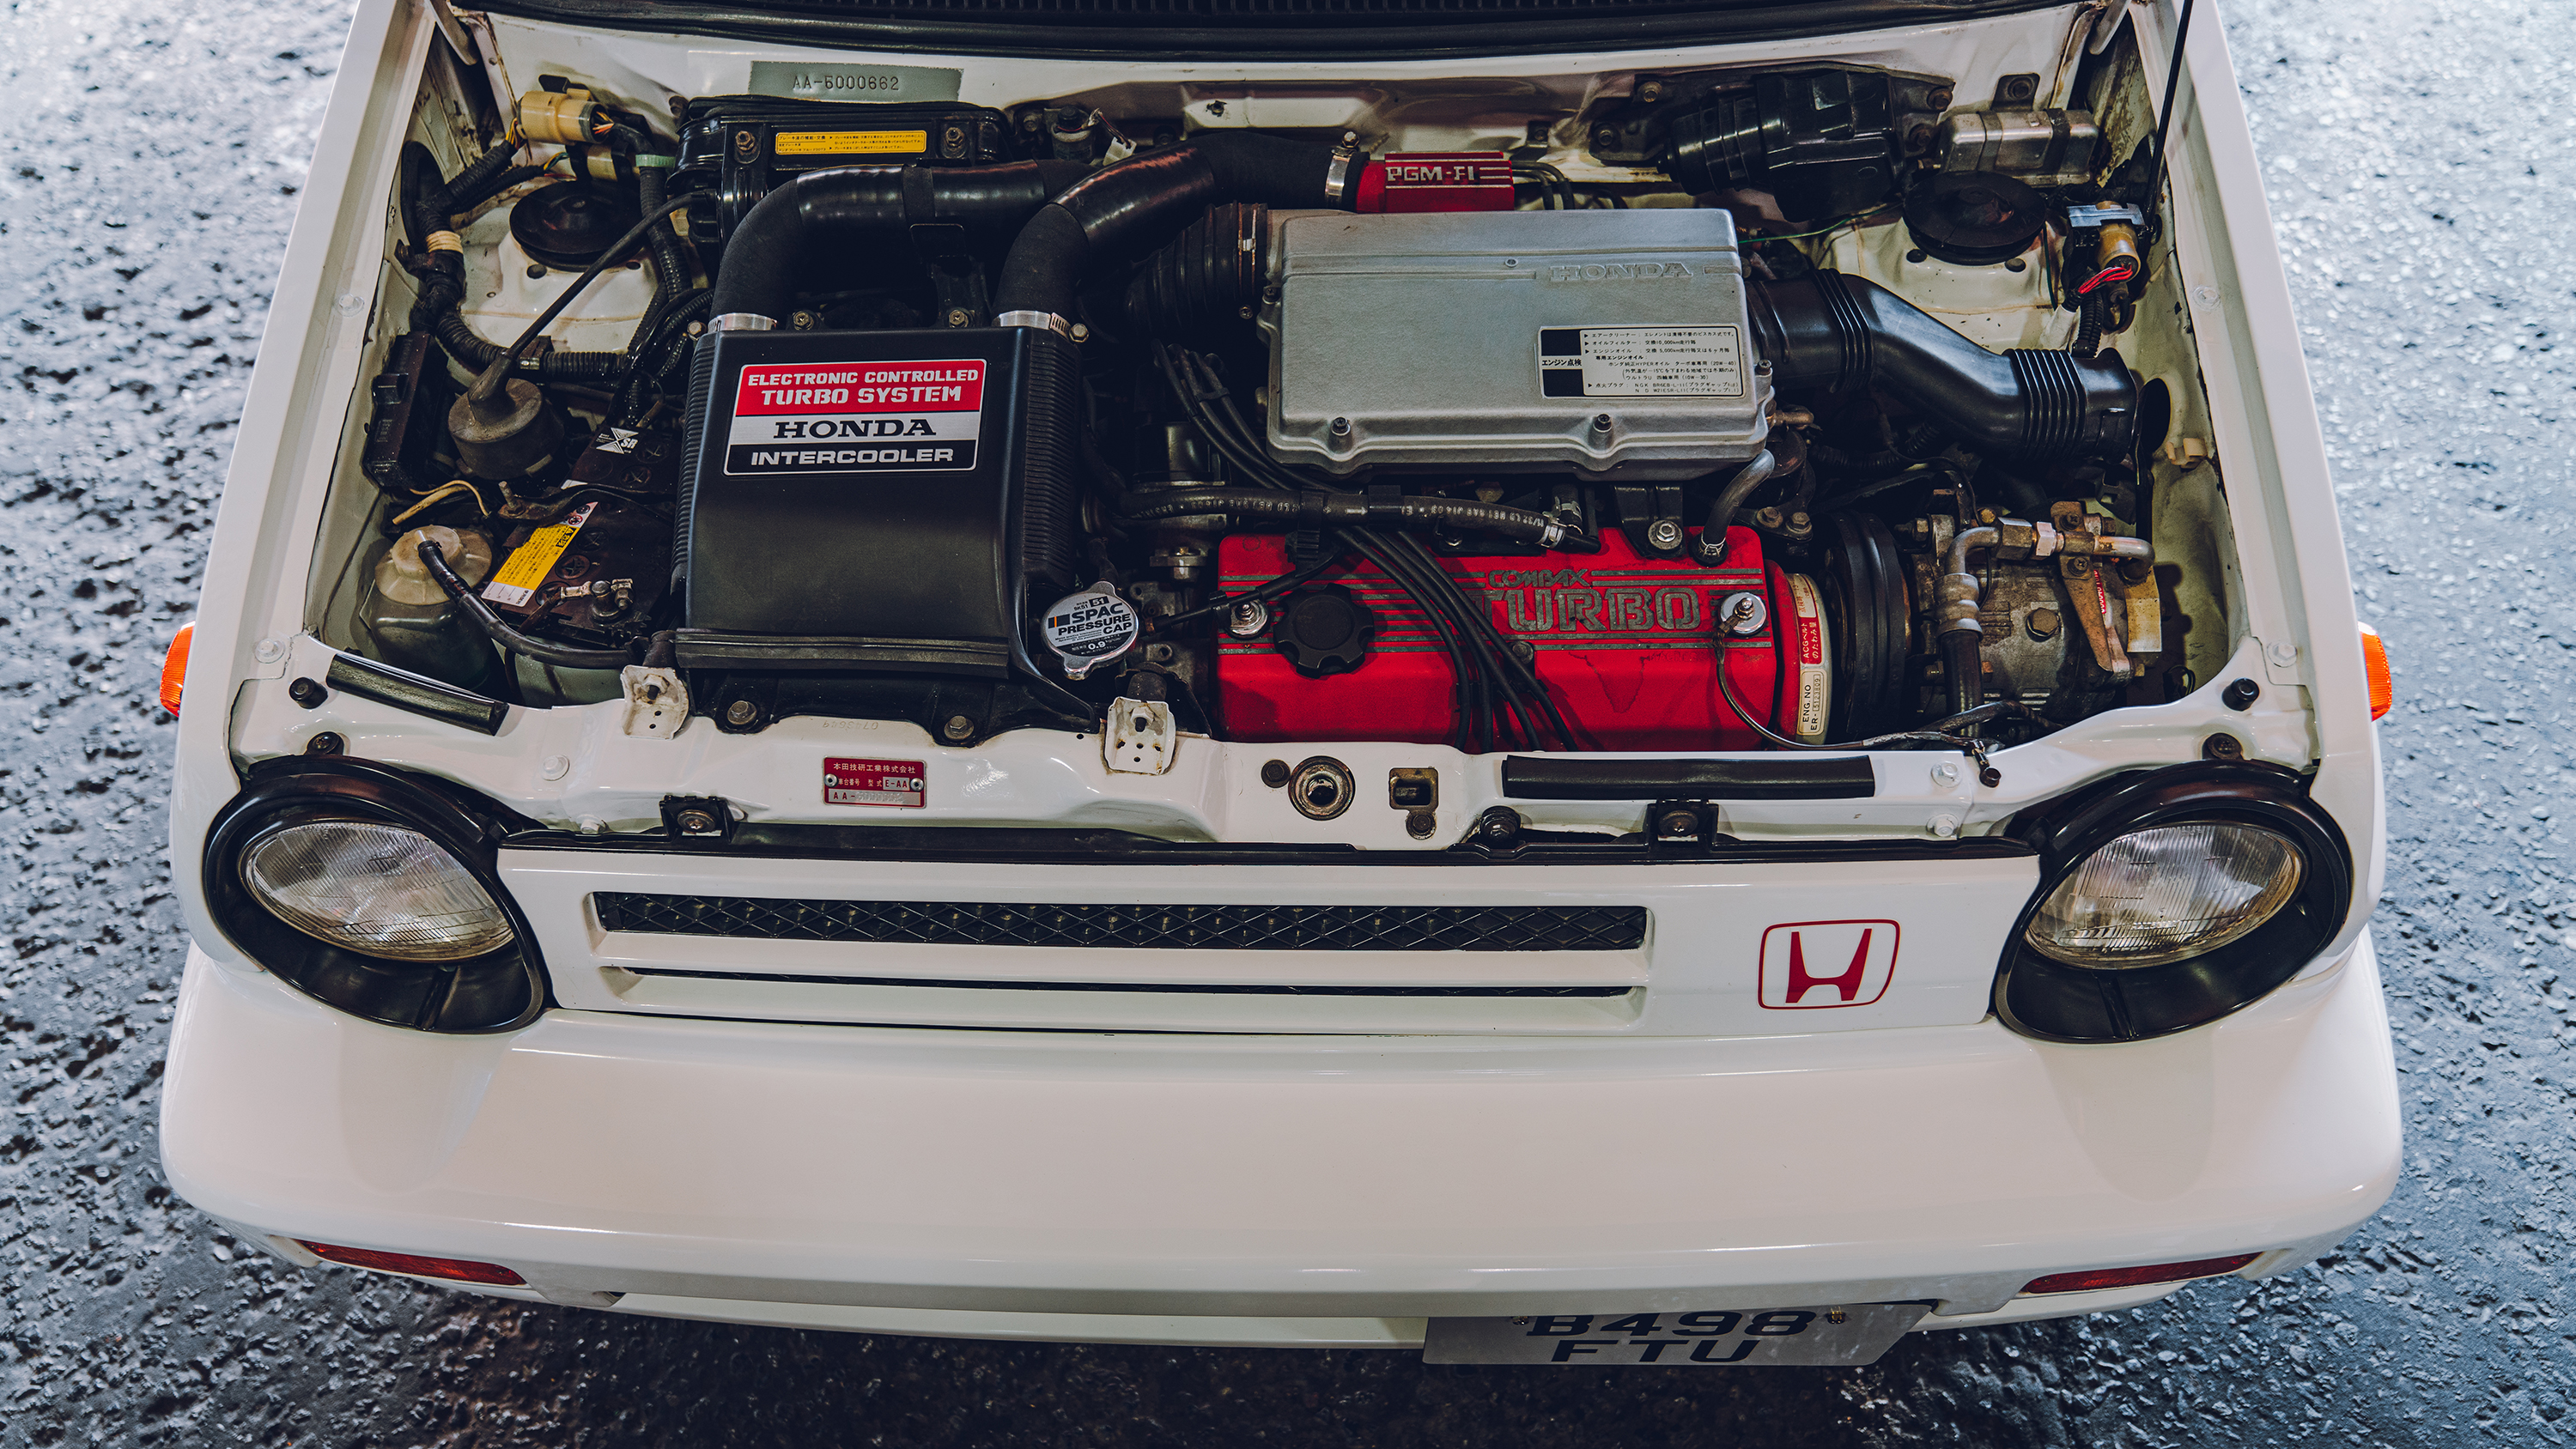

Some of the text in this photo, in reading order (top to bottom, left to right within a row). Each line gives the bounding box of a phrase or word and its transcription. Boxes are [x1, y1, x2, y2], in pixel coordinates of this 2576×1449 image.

[793, 76, 900, 91] AA-5000662
[1385, 166, 1475, 182] PGM-FI
[1549, 262, 1693, 282] HONDA
[1541, 358, 1583, 367] エンジン点検
[748, 369, 979, 385] ELECTRONIC CONTROLLED
[762, 386, 962, 405] TURBO SYSTEM
[774, 419, 936, 439] HONDA
[750, 448, 954, 465] INTERCOOLER
[1488, 568, 1590, 587] COMBAX
[1092, 597, 1106, 606] 51
[1072, 603, 1124, 624] SPAC
[1058, 613, 1131, 636] PRESSURE
[1103, 621, 1132, 634] CAP
[1088, 640, 1106, 650] 0.9
[1802, 684, 1812, 723] ENG. NO
[833, 762, 916, 774] 本田技研工業株式会社
[884, 779, 908, 789] E-AA
[1526, 1311, 1817, 1337] B498
[1551, 1339, 1762, 1362] FTU
